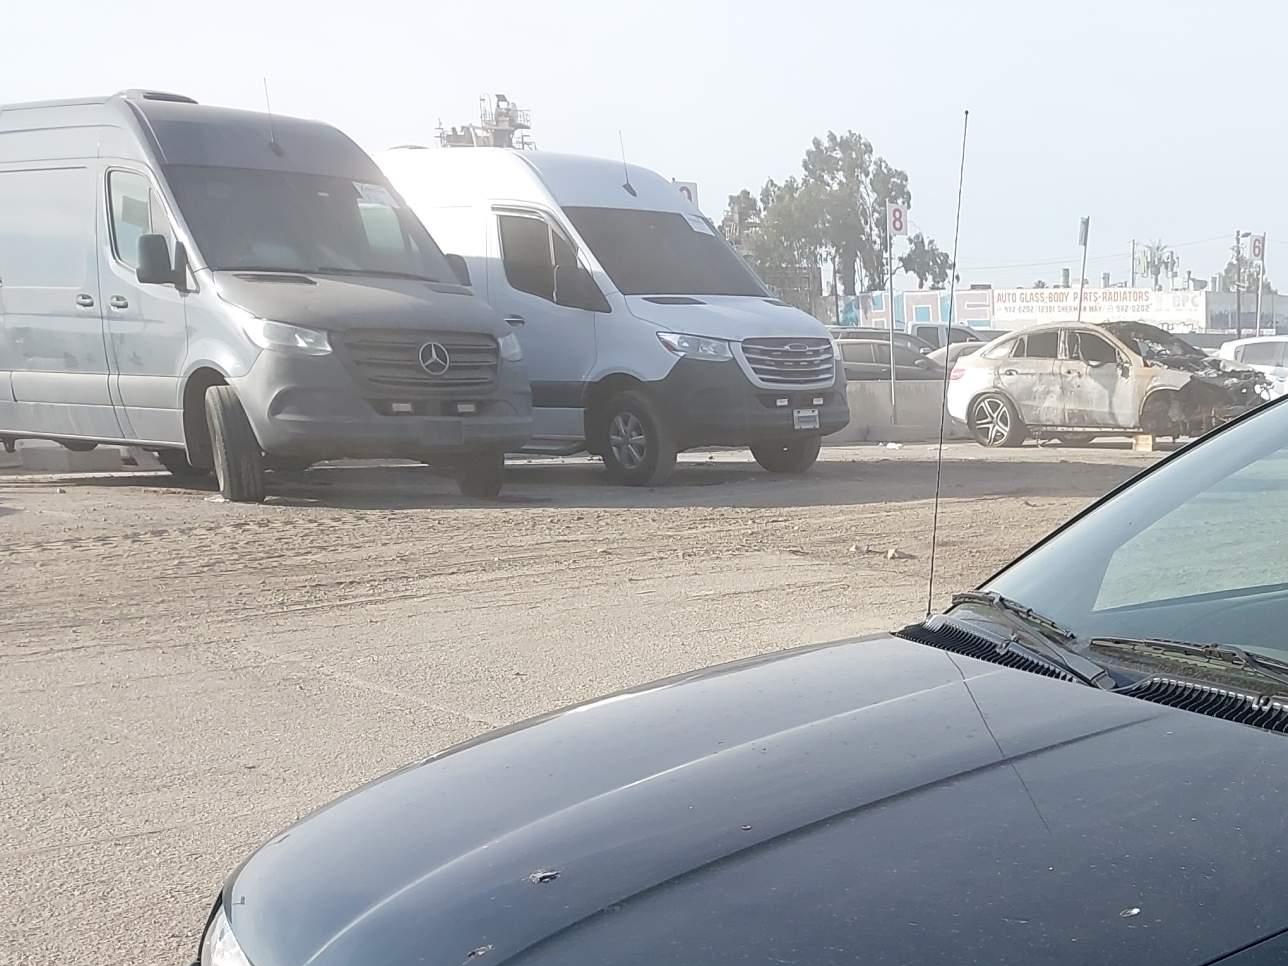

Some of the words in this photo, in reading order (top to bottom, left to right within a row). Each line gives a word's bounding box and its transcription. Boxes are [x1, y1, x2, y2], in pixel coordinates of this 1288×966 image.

[892, 207, 903, 232] 8
[1253, 238, 1261, 257] 6
[997, 291, 1017, 303] AUTO
